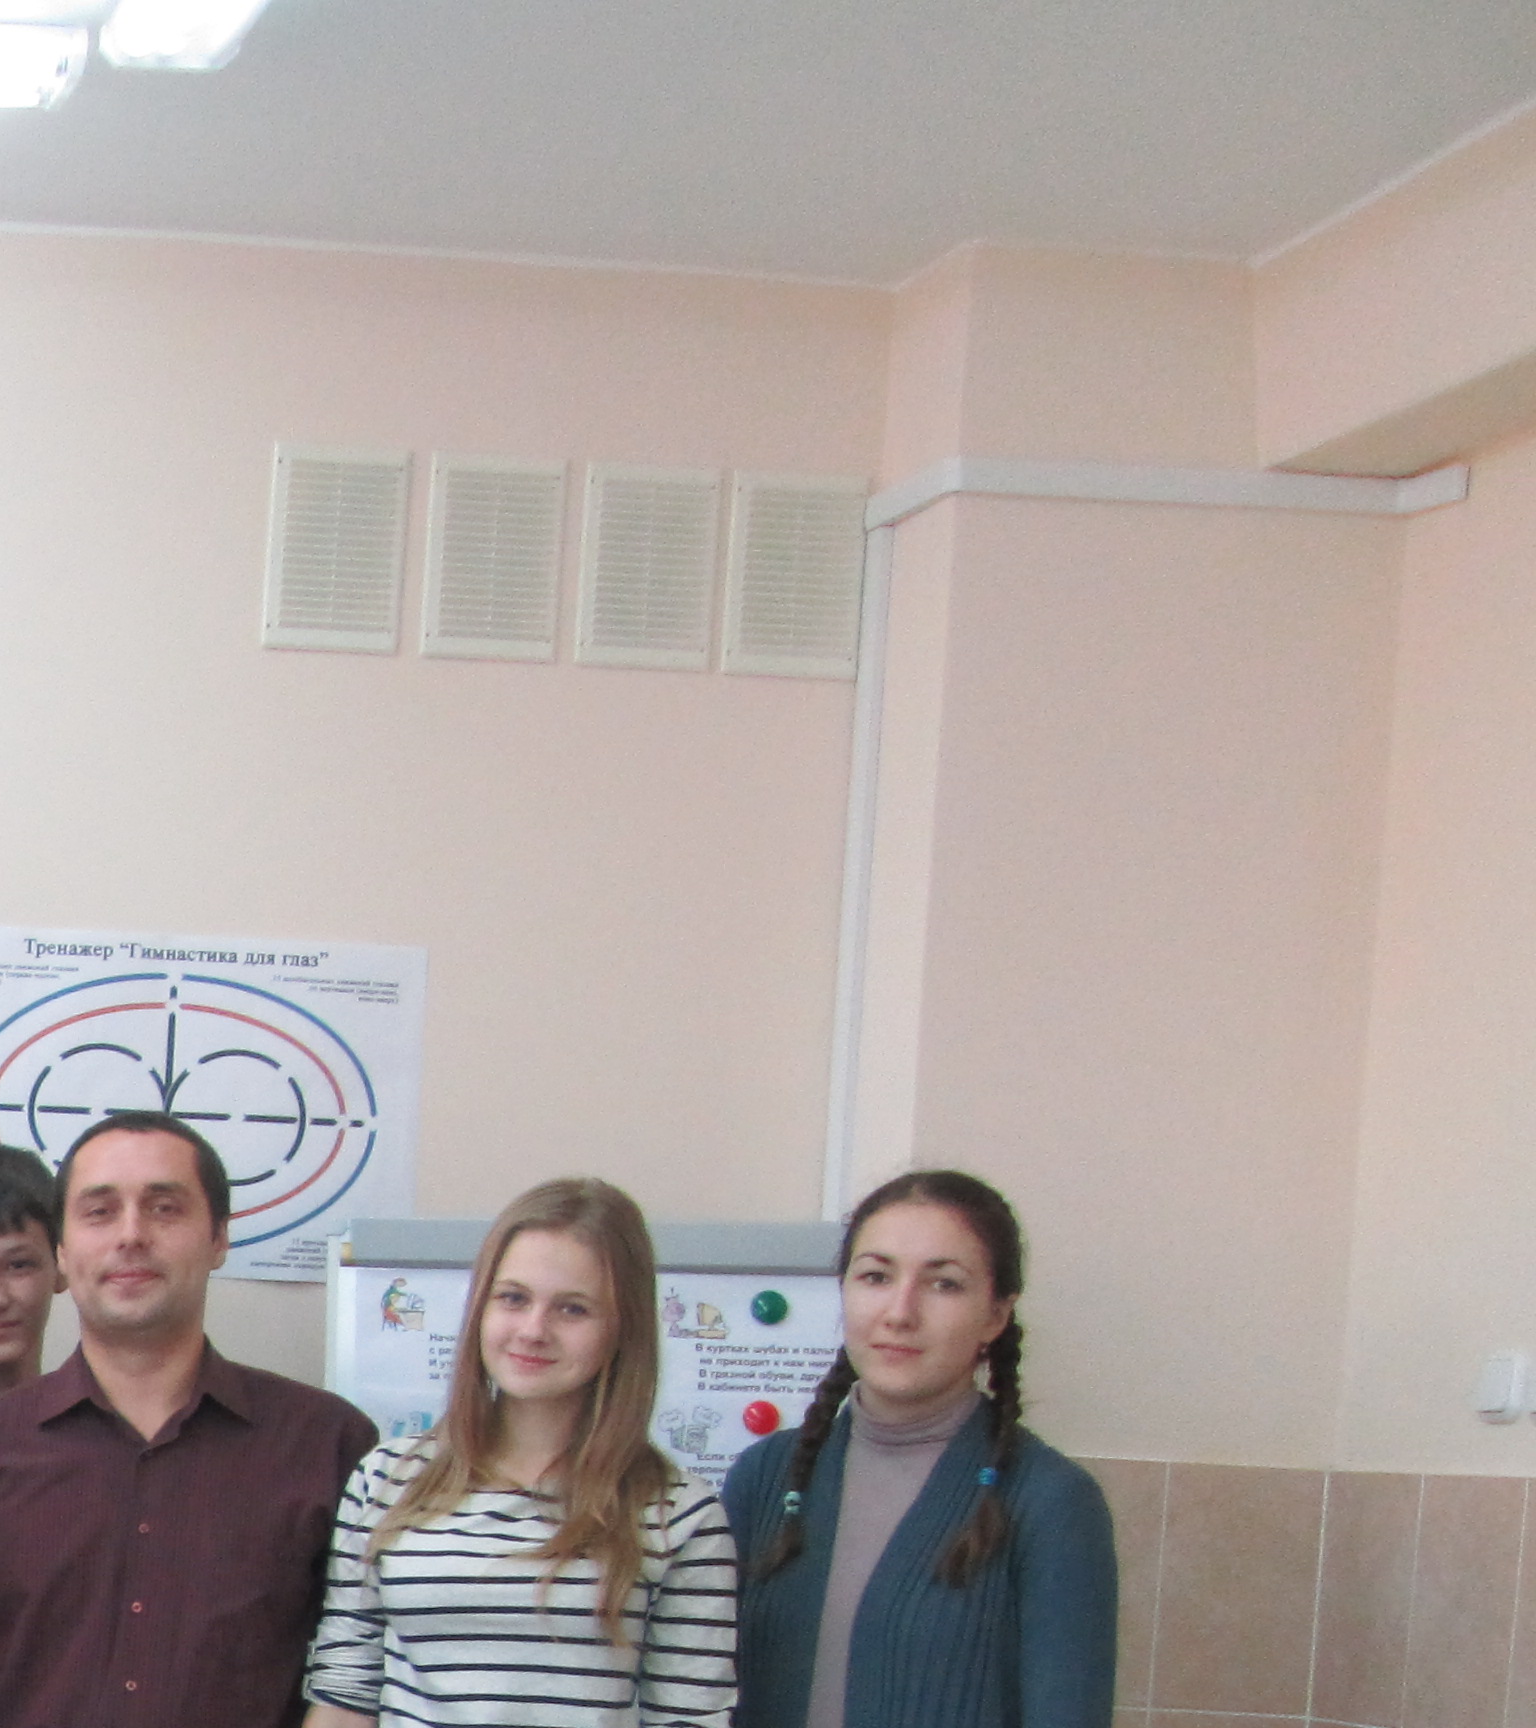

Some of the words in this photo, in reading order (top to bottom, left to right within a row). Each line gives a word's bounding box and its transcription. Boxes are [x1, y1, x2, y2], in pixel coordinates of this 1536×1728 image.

[24, 938, 114, 961] Тренажер
[243, 950, 276, 966] для
[706, 1345, 749, 1354] куртках
[753, 1345, 789, 1355] шубах
[716, 1358, 770, 1368] приходит
[699, 1369, 707, 1378] В
[697, 1382, 705, 1391] В
[763, 1383, 793, 1394] быть
